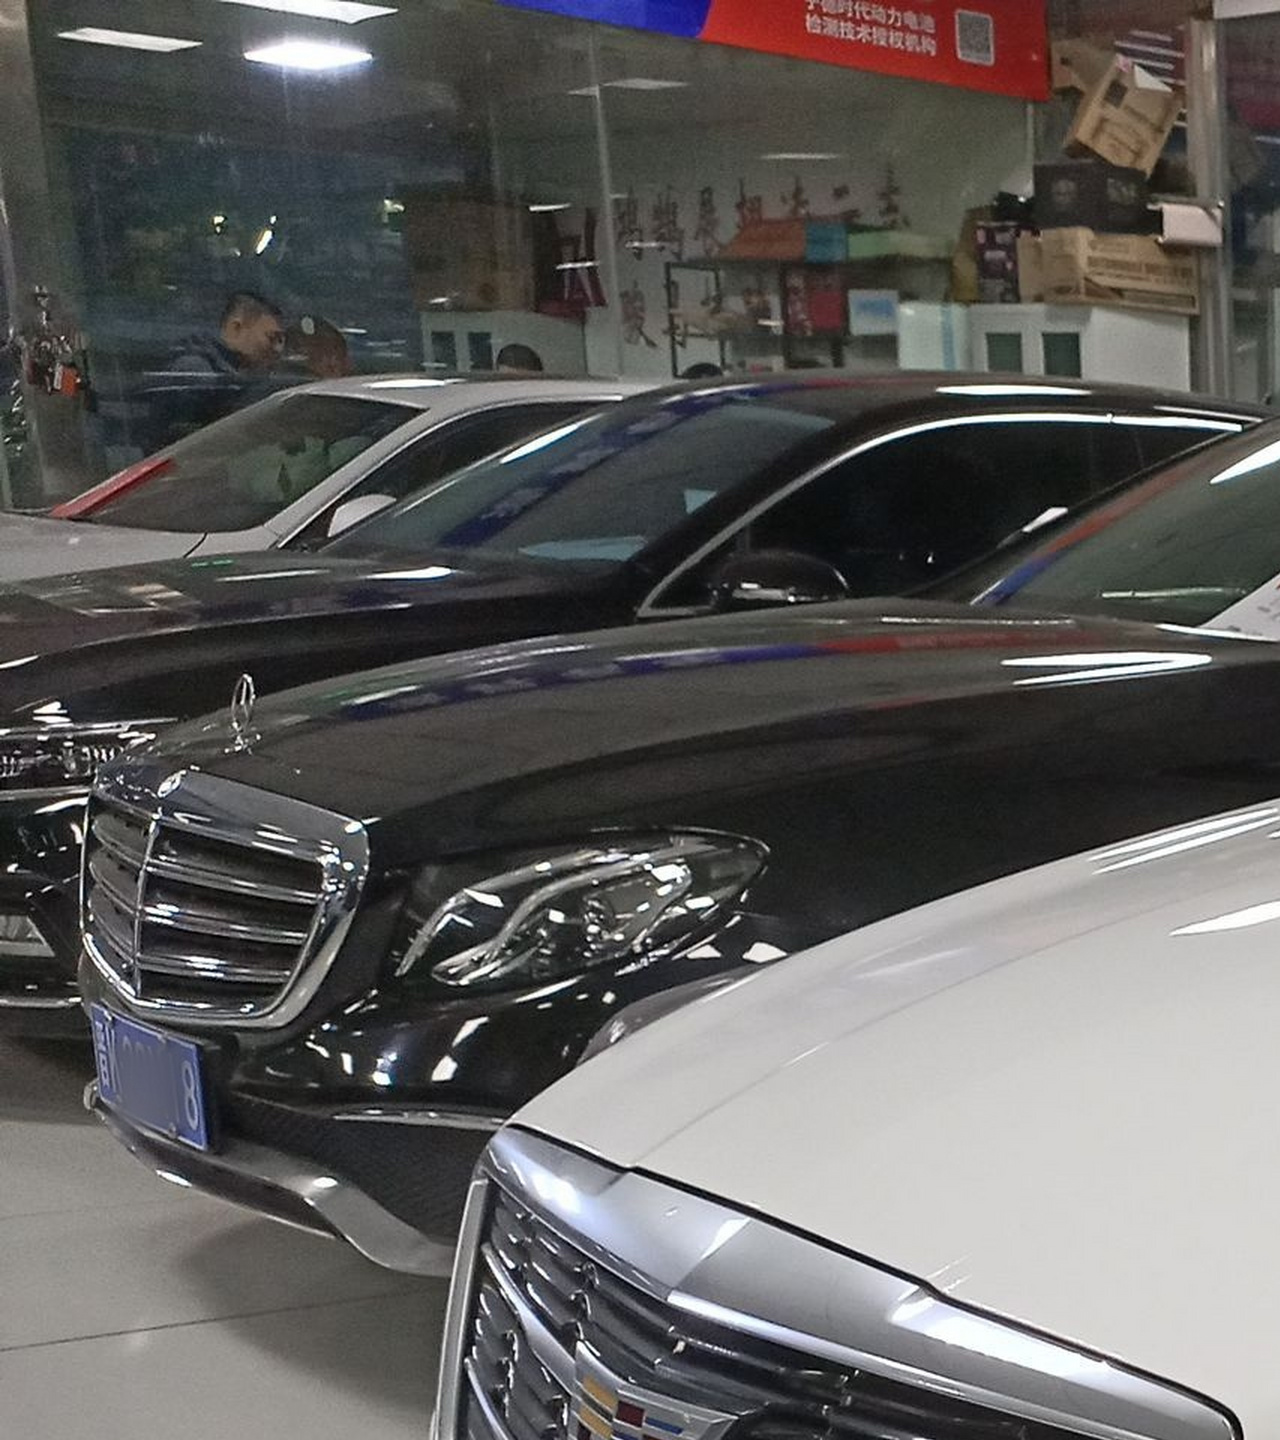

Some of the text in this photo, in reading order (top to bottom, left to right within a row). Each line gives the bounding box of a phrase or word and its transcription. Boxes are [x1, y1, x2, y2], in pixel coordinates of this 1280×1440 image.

[806, 14, 937, 57] 检测技术授权机构
